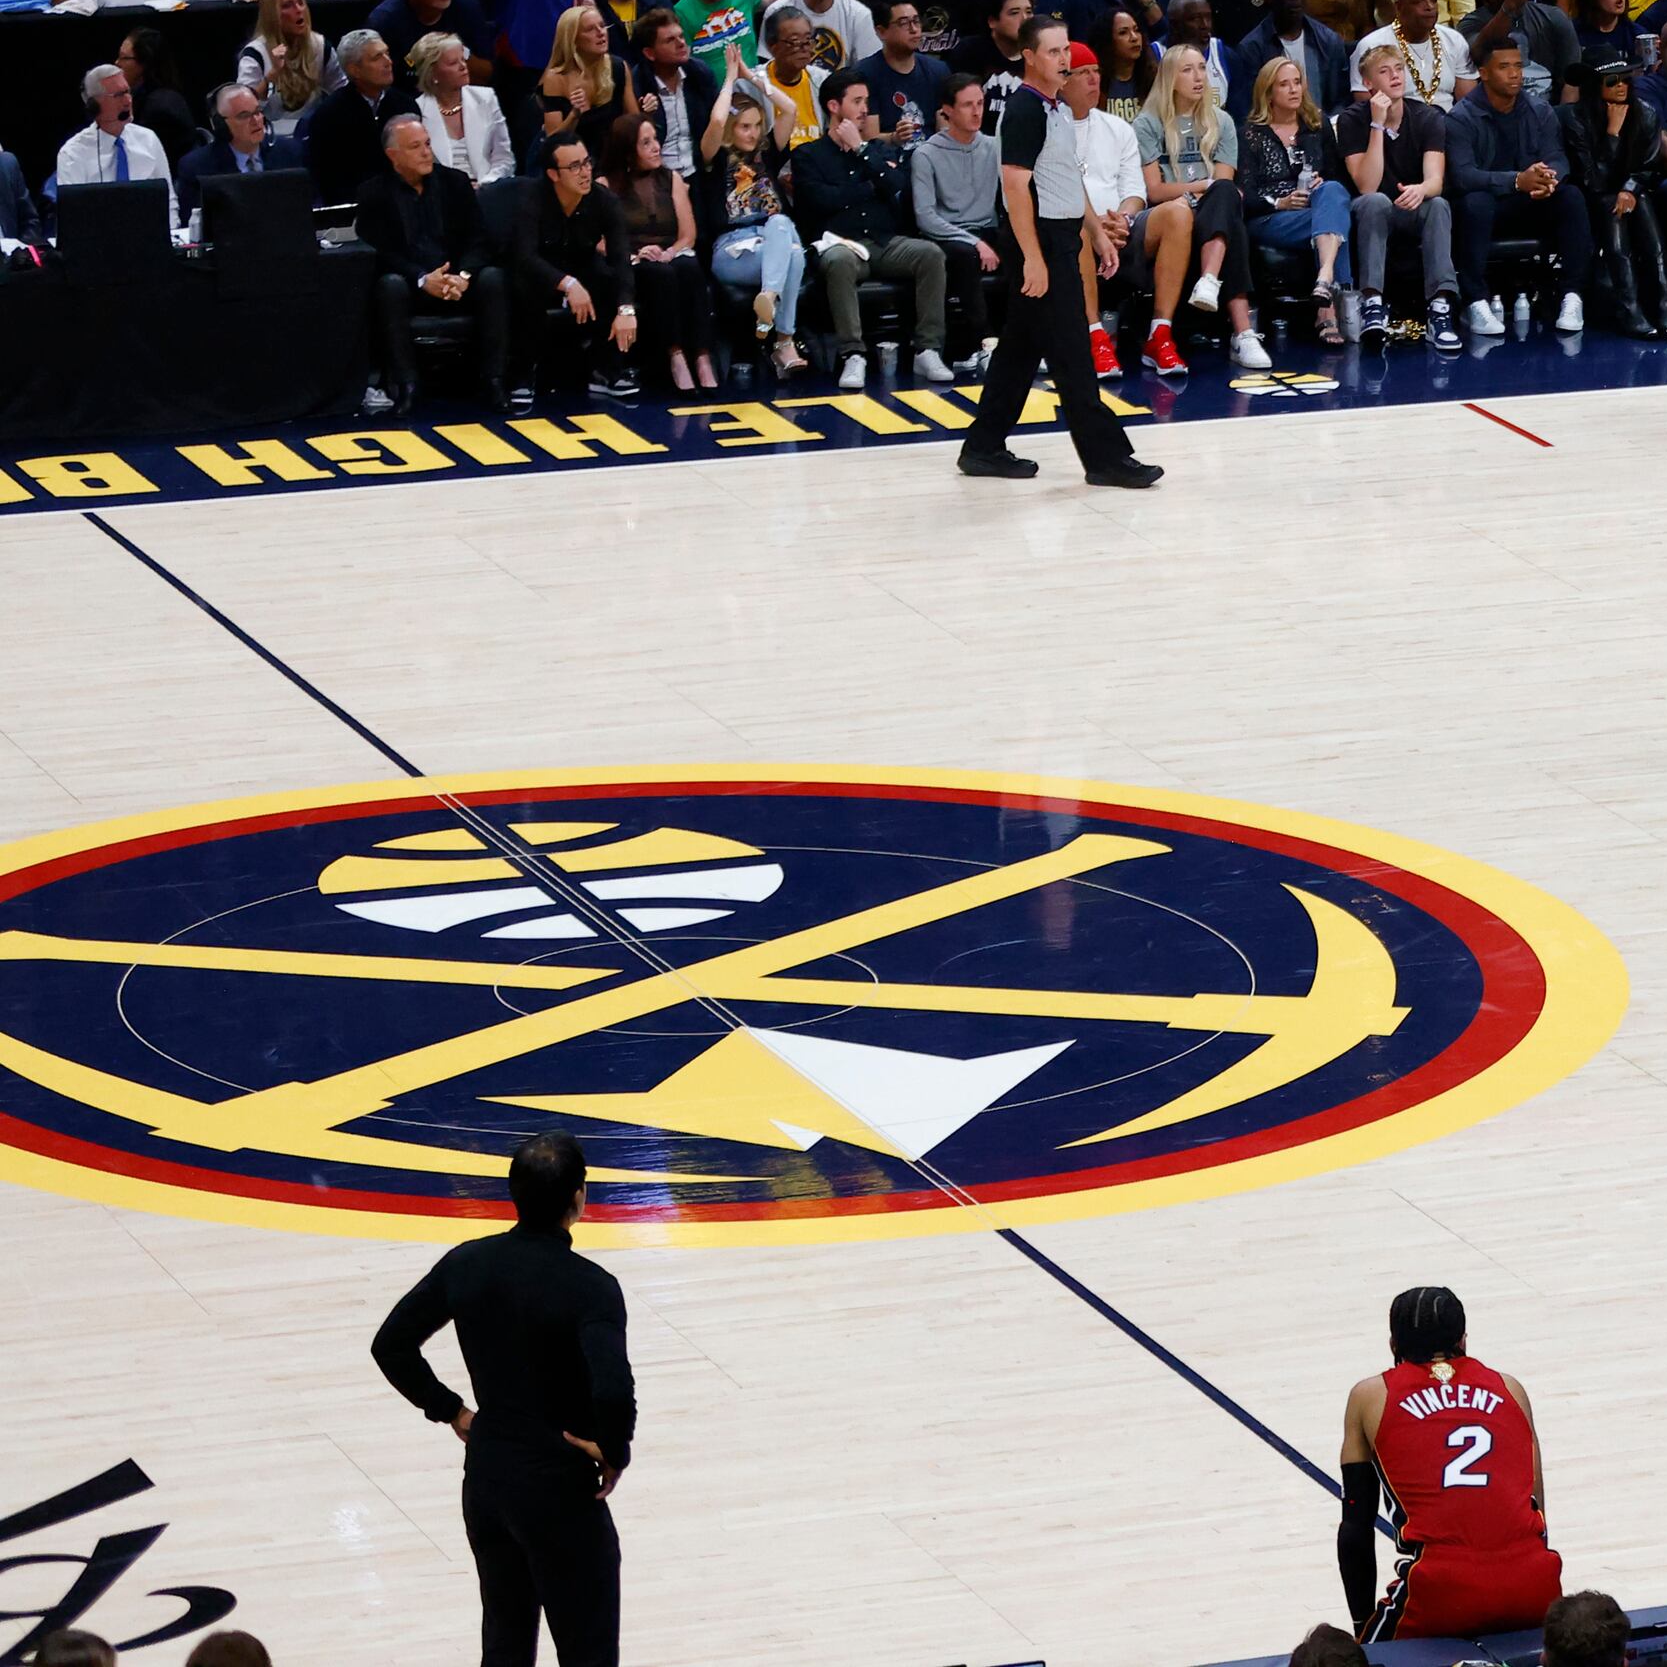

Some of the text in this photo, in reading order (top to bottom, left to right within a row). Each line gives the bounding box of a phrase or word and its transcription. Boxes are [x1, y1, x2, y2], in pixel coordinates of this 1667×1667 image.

[176, 413, 667, 488] HIGH
[1399, 1382, 1505, 1421] VINCENT
[1442, 1425, 1493, 1488] 2
